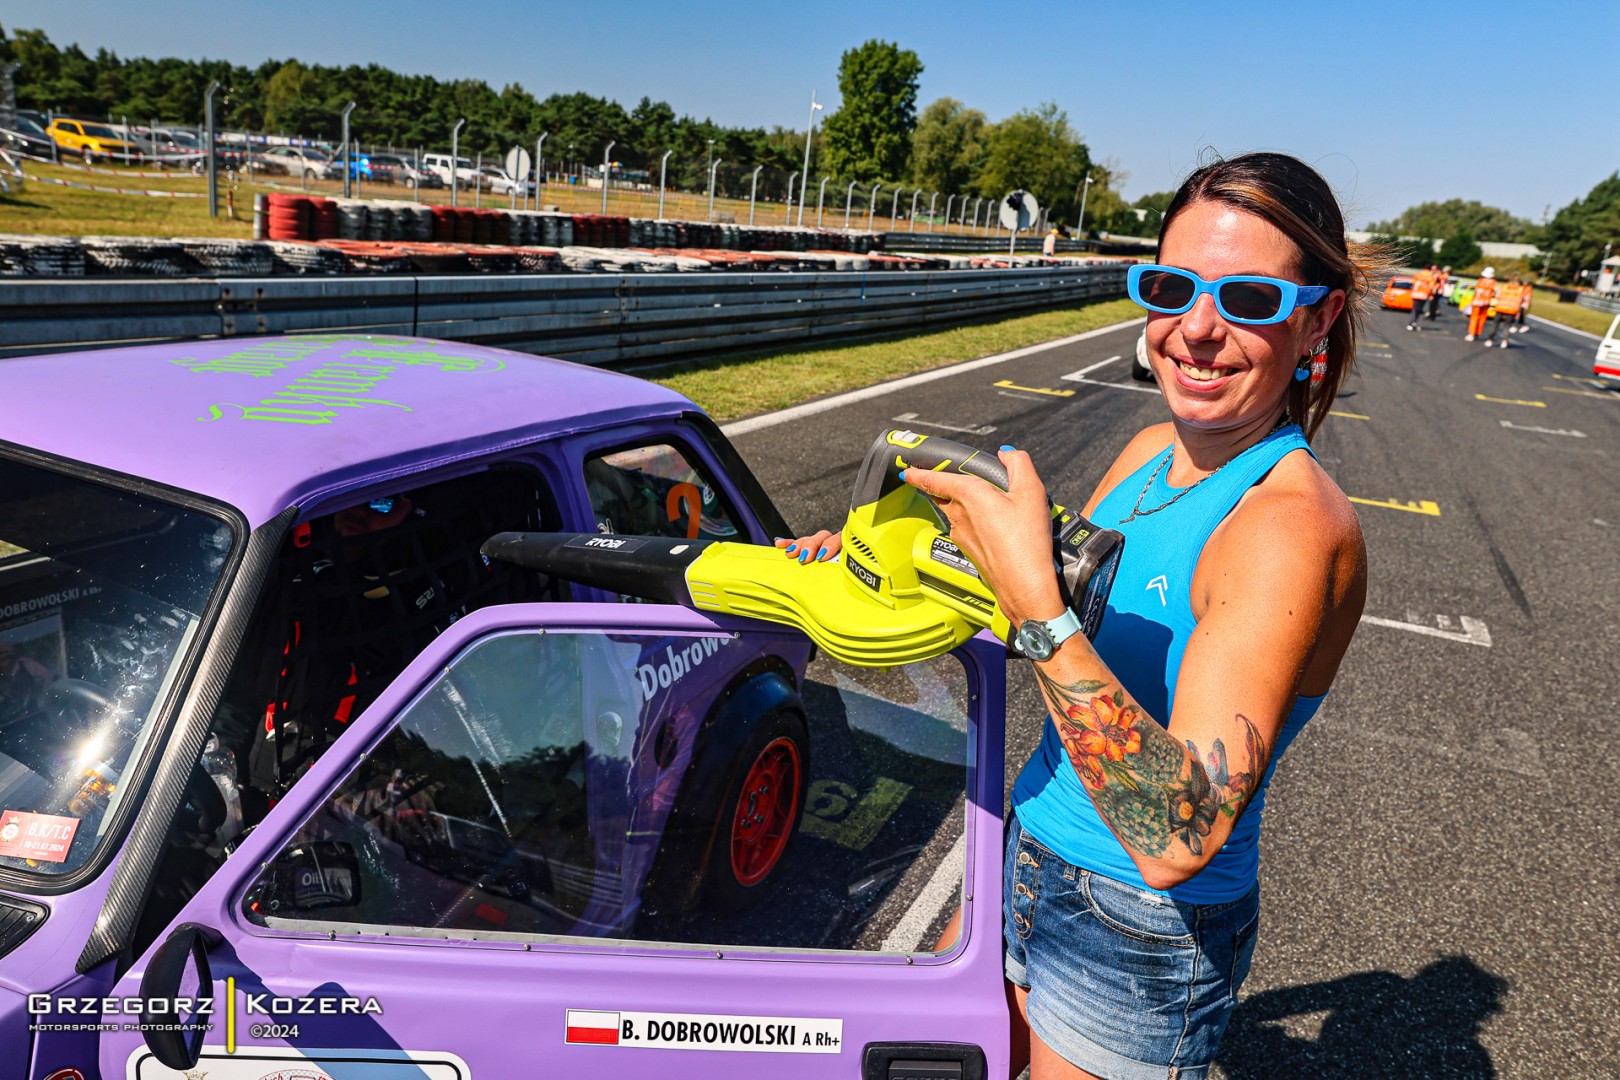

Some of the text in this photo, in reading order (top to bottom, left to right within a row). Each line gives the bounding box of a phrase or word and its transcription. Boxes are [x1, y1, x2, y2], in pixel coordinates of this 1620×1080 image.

[585, 537, 627, 549] RYOBI
[934, 538, 959, 553] RYOBI
[849, 558, 877, 587] RYOBI
[621, 1019, 840, 1046] B. DOBROWOLSKI A Rh+
